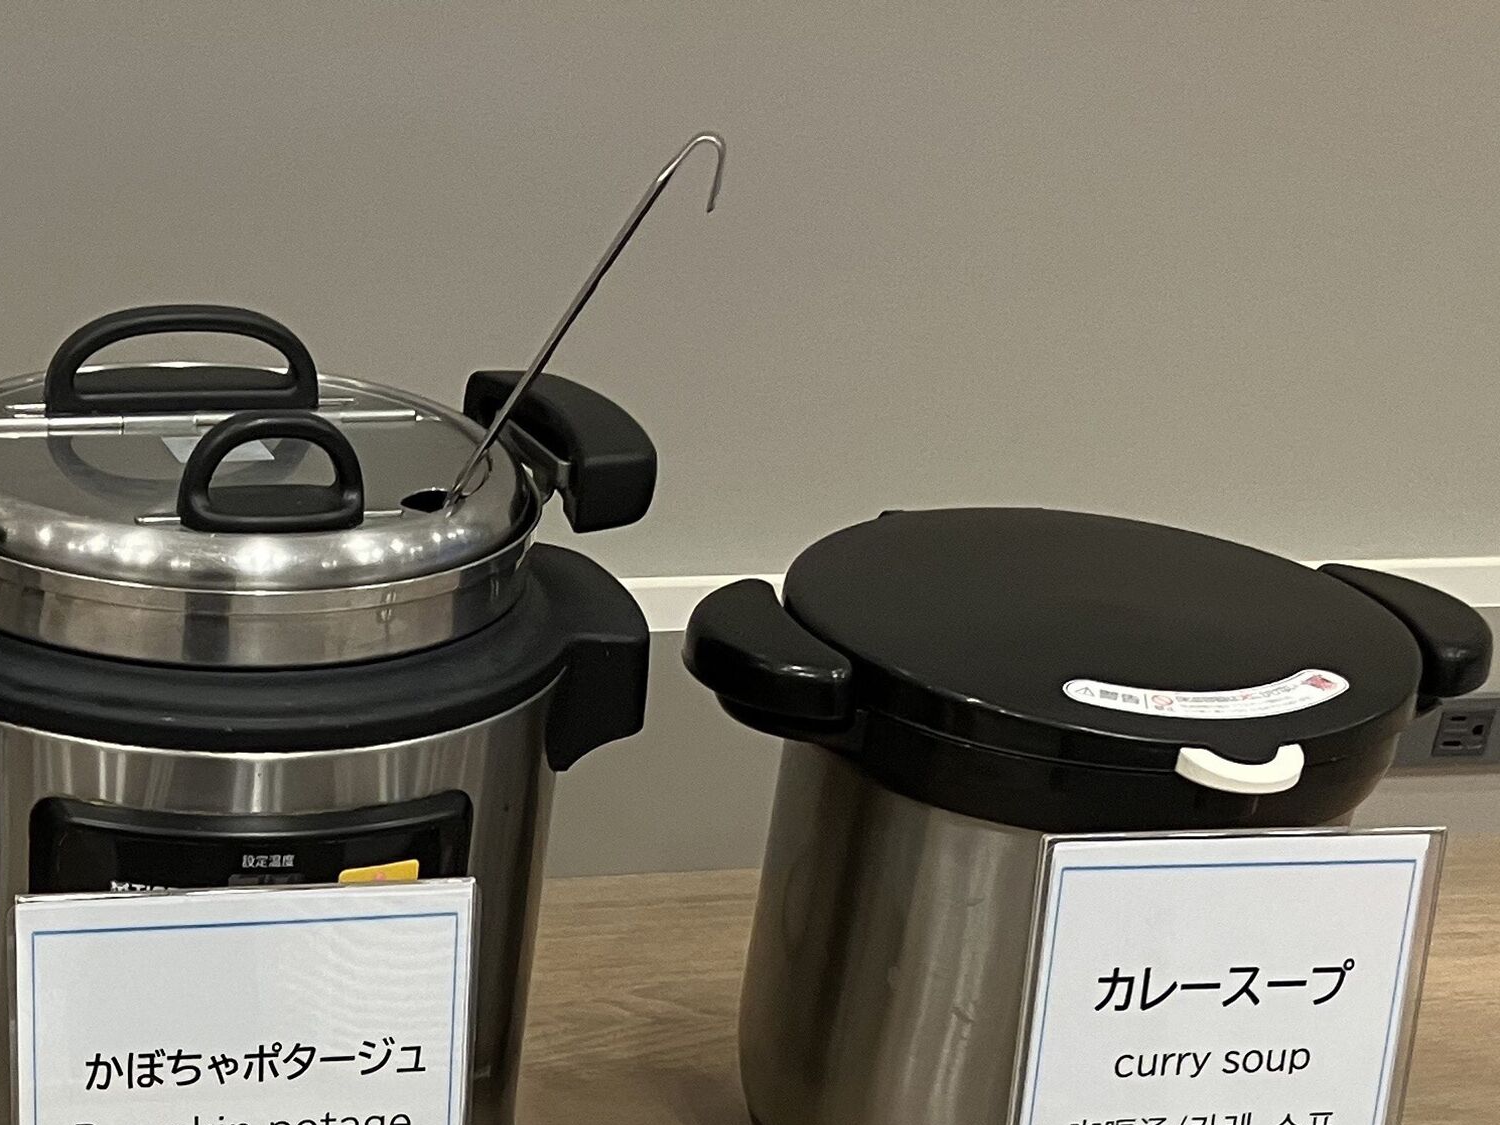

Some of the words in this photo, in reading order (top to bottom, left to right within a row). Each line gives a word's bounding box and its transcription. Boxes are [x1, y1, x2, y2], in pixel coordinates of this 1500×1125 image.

[242, 855, 294, 867] 設定温度
[1094, 958, 1355, 1011] カレースープ
[85, 1037, 426, 1091] かぼちゃポタージュ
[1114, 1052, 1211, 1078] curry
[1221, 1048, 1311, 1075] soup
